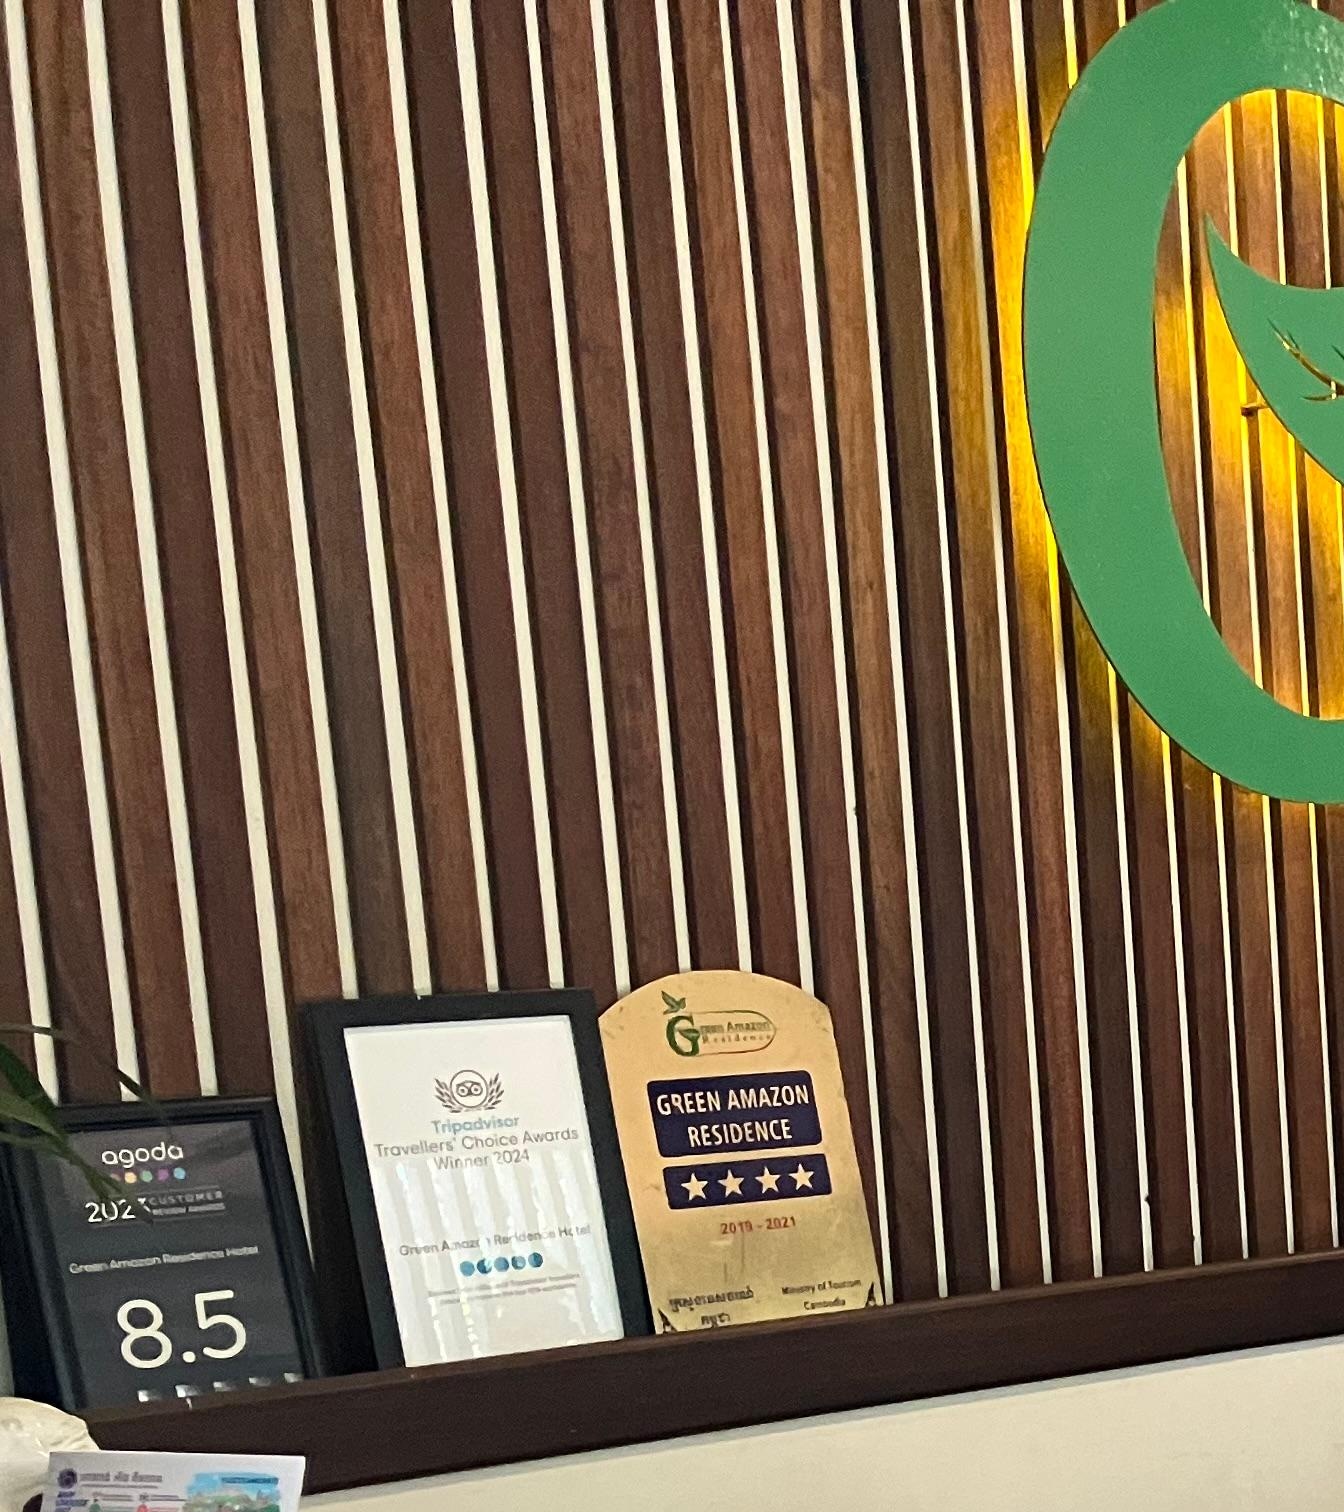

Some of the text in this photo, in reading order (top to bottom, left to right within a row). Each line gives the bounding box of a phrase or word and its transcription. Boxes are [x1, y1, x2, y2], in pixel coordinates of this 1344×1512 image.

[656, 1085, 809, 1116] GREEN AMAZON
[431, 1115, 520, 1134] Tripadvisor
[687, 1118, 793, 1148] RESIDENCE
[101, 1141, 184, 1168] agoda
[374, 1128, 579, 1158] Travellers' Choice Awards
[434, 1149, 530, 1171] Winner 2024
[766, 1216, 797, 1231] 2021
[400, 1244, 439, 1257] Green
[117, 1289, 247, 1369] 8.5
